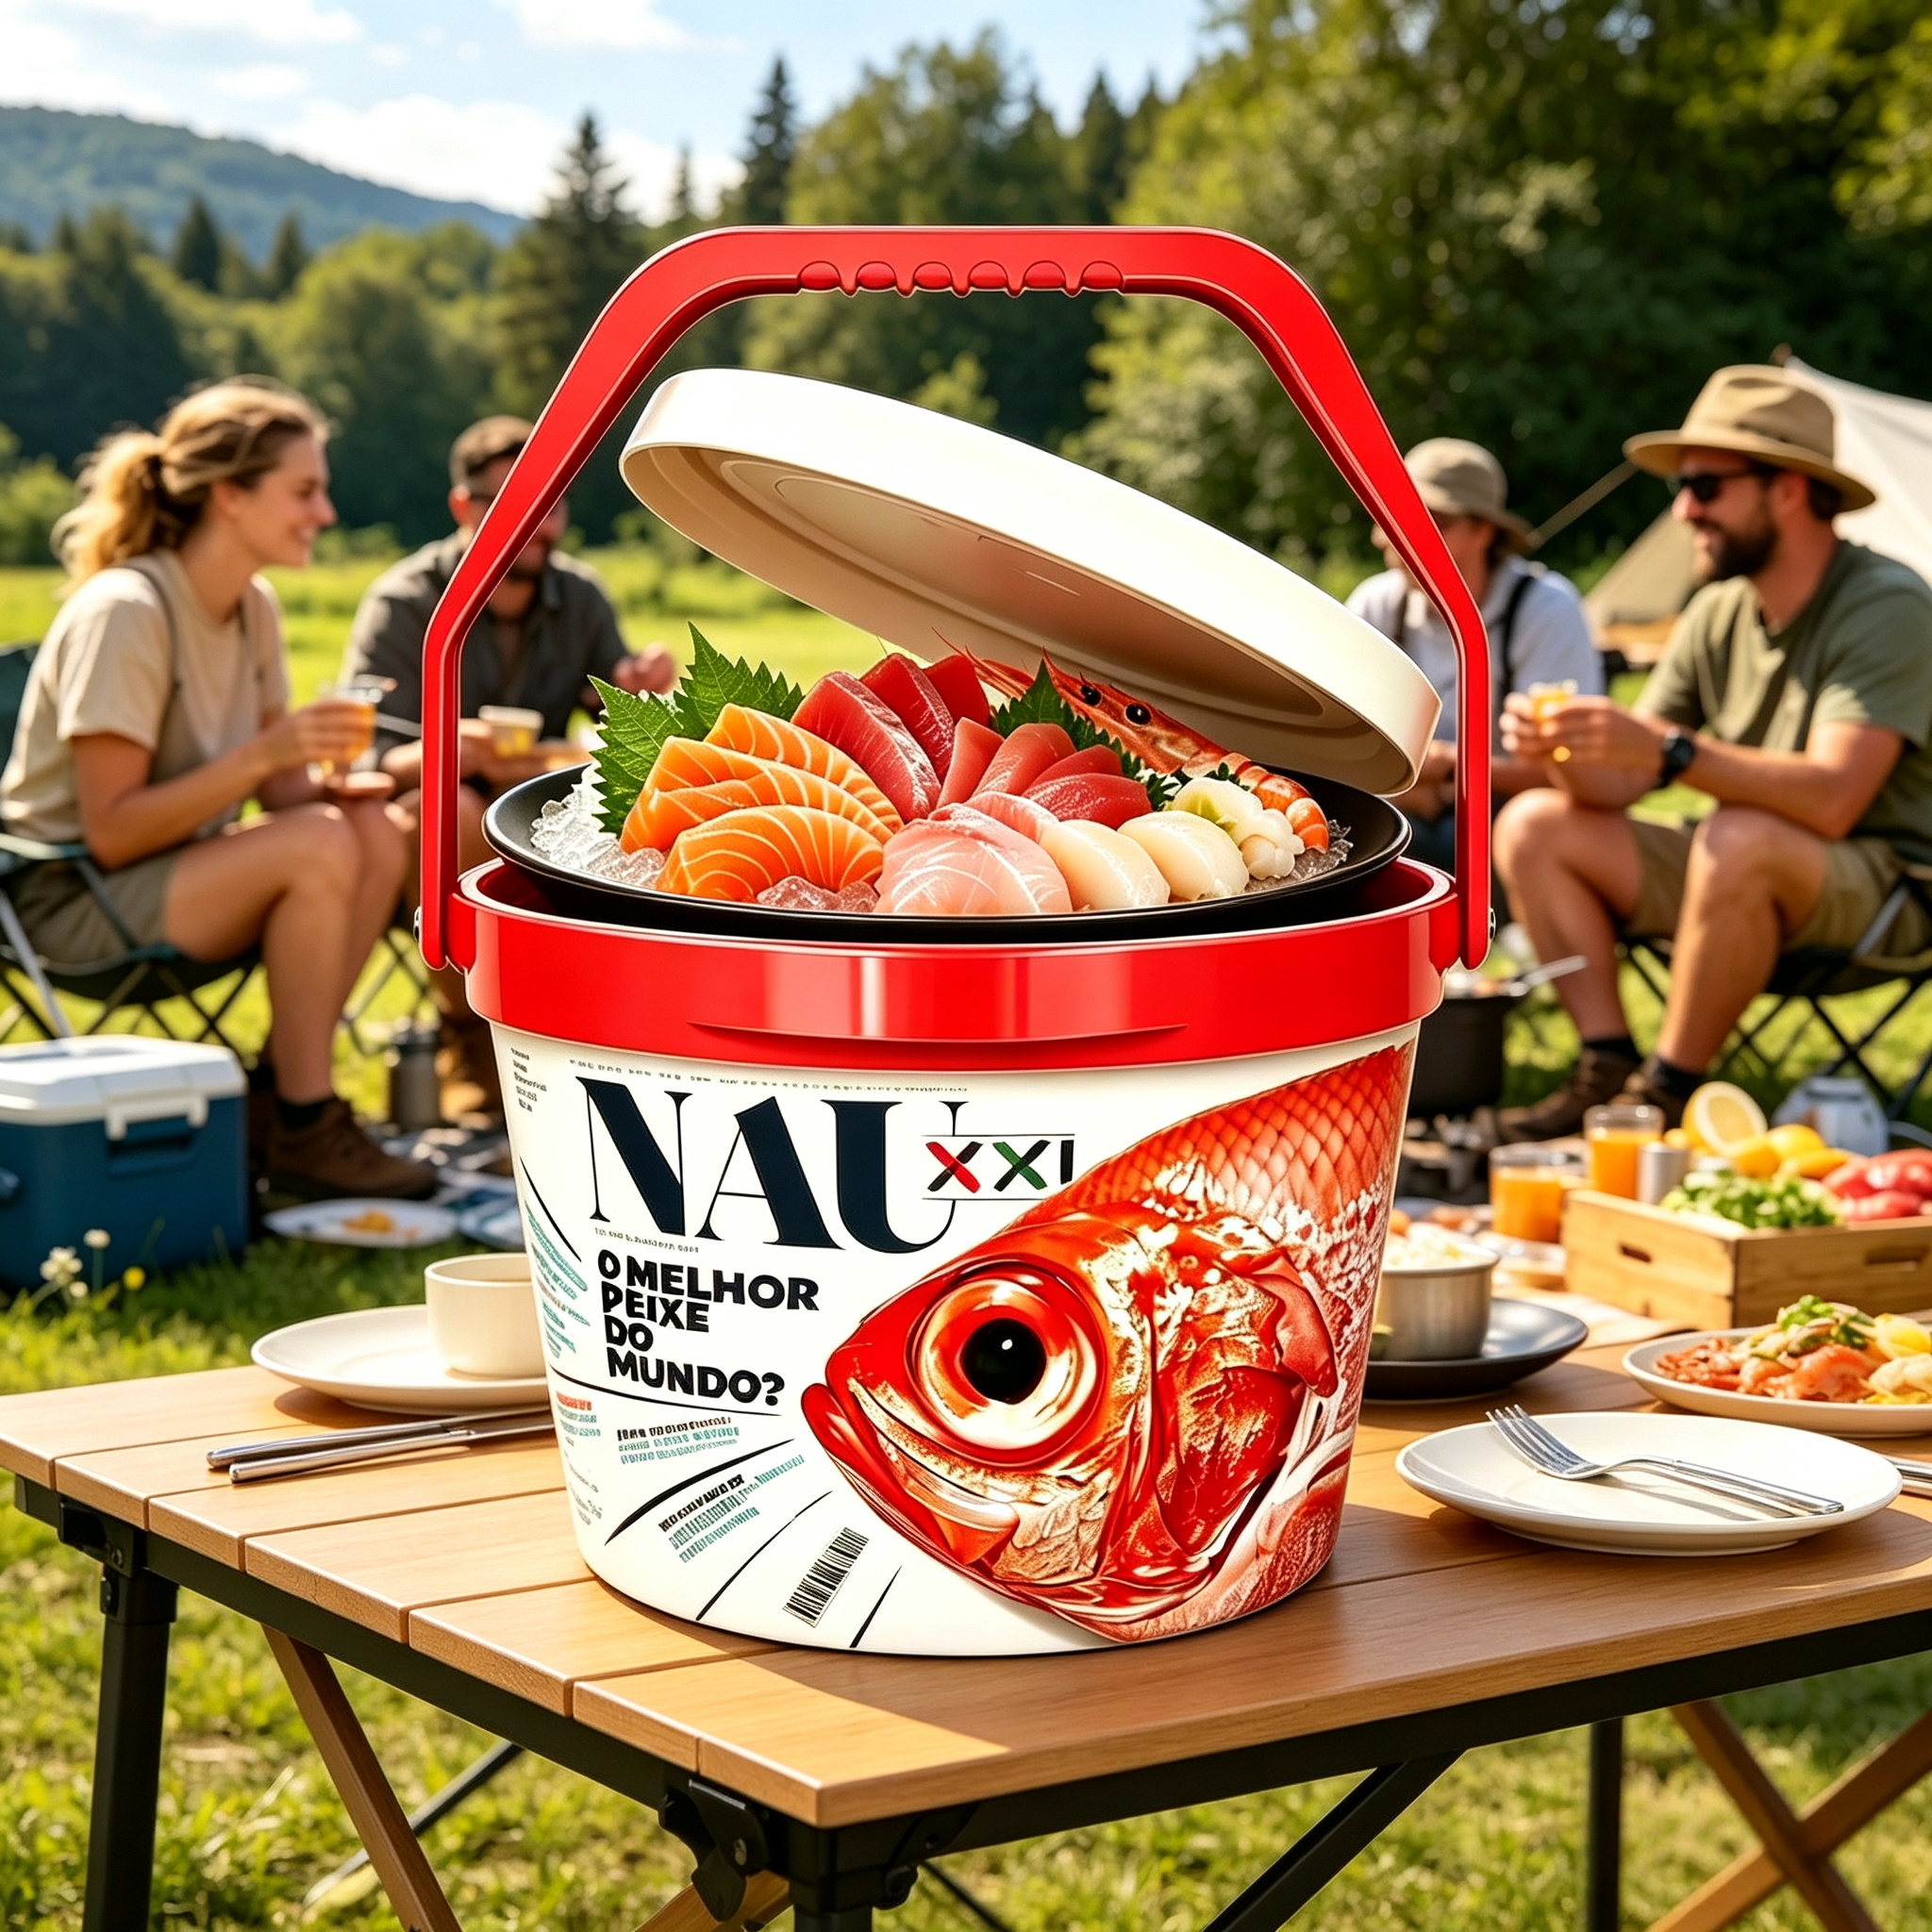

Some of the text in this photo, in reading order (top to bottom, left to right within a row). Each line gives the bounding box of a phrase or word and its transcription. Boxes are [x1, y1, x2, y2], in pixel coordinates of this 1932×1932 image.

[575, 1075, 970, 1255] NAU
[924, 1139, 1075, 1194] XXI
[597, 1249, 622, 1280] O
[626, 1255, 820, 1311] MELHOR
[601, 1280, 709, 1333] PEIXE
[604, 1314, 654, 1352] DO
[606, 1346, 785, 1406] MUNDO?
